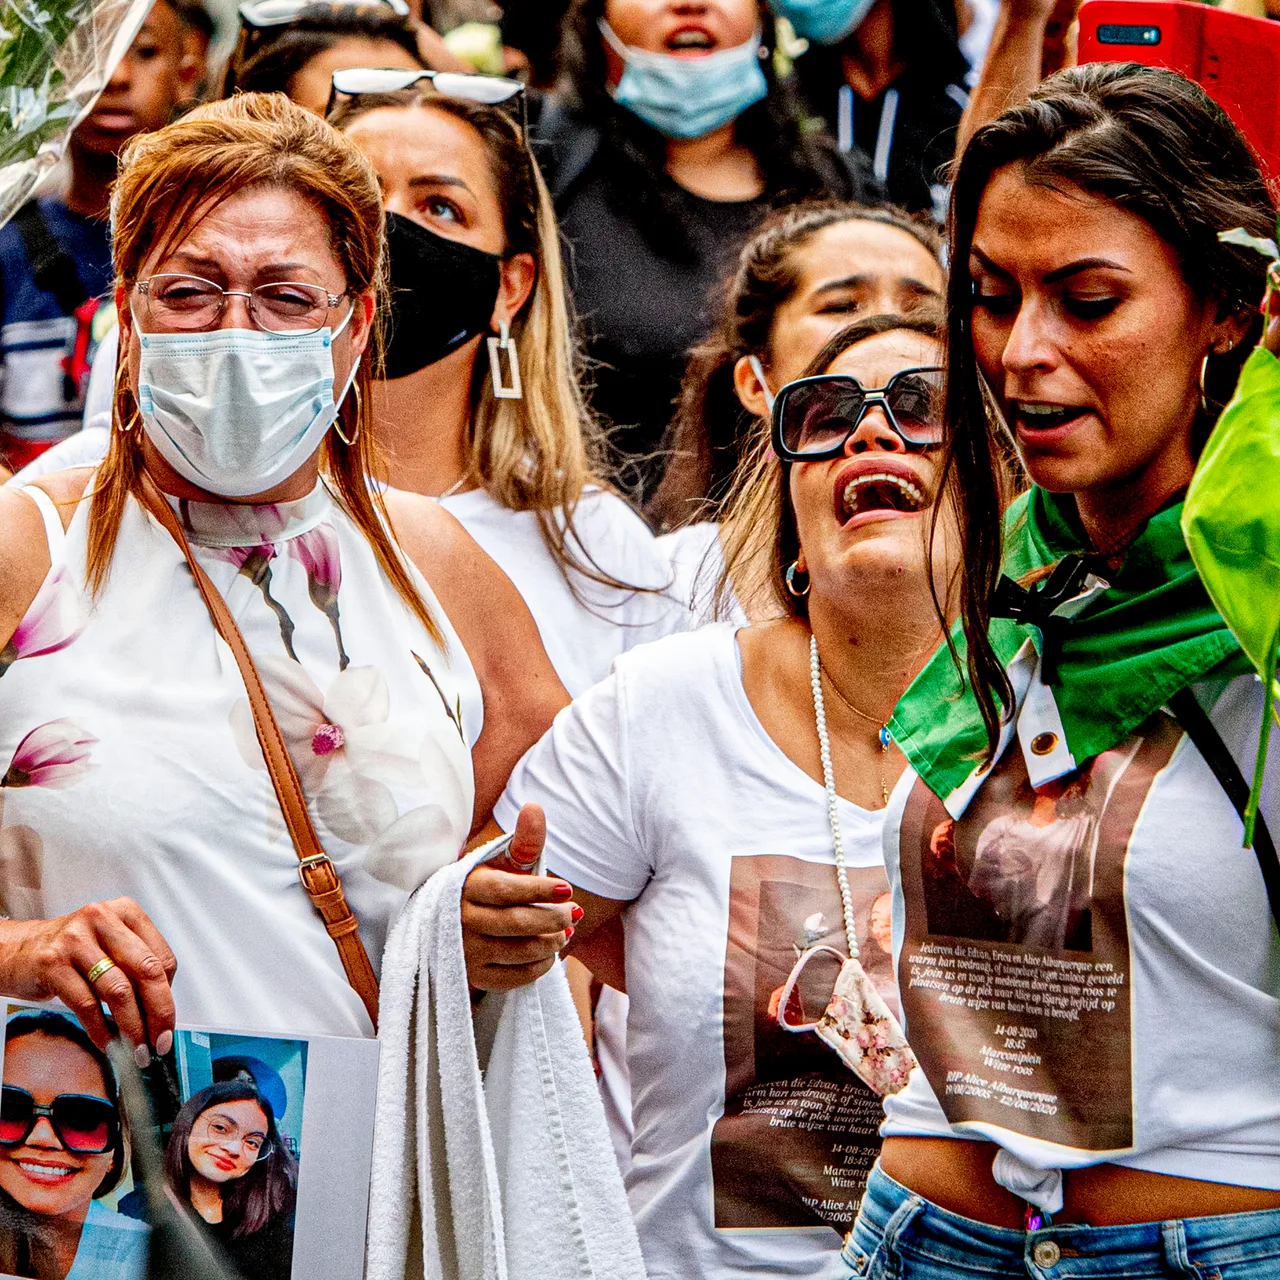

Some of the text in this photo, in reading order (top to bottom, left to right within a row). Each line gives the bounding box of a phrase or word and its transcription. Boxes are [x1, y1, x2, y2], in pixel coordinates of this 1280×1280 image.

[954, 946, 967, 957] die
[1023, 954, 1041, 966] Alice
[1095, 962, 1113, 972] een
[908, 955, 937, 966] warm
[938, 956, 955, 967] hart
[1086, 973, 1124, 987] geweld
[920, 967, 943, 978] join
[945, 971, 955, 980] us
[957, 972, 967, 981] en
[968, 973, 986, 982] toon
[1083, 988, 1104, 997] roos
[1108, 988, 1117, 997] te
[908, 975, 950, 991] plaatsen
[952, 984, 964, 995] op
[965, 983, 976, 995] de
[977, 986, 993, 999] plek
[1101, 1000, 1115, 1013] op
[939, 992, 966, 1006] brute
[968, 998, 989, 1010] wijze
[991, 1000, 1006, 1010] van
[995, 1024, 1037, 1039] 14-08-2020
[1004, 1038, 1026, 1050] 18:45
[980, 1045, 1042, 1065] Marconiplein
[984, 1056, 1034, 1076] Witte roos
[946, 1071, 1058, 1104] RIP Alice Alburquerque
[769, 1088, 789, 1098] hart
[840, 1094, 854, 1107] of
[787, 1099, 798, 1107] en
[800, 1100, 823, 1111] toon
[1000, 1095, 1057, 1115] 12/08/2020
[780, 1108, 793, 1118] op
[794, 1108, 808, 1118] de
[809, 1112, 831, 1122] plek
[770, 1116, 797, 1128] brute
[827, 1124, 846, 1132] van
[848, 1124, 874, 1135] haar
[832, 1144, 880, 1157] 14-08-202
[844, 1156, 869, 1166] 18:45
[822, 1165, 869, 1180] Marconip
[831, 1177, 856, 1188] Witte
[819, 1199, 845, 1210] Alice
